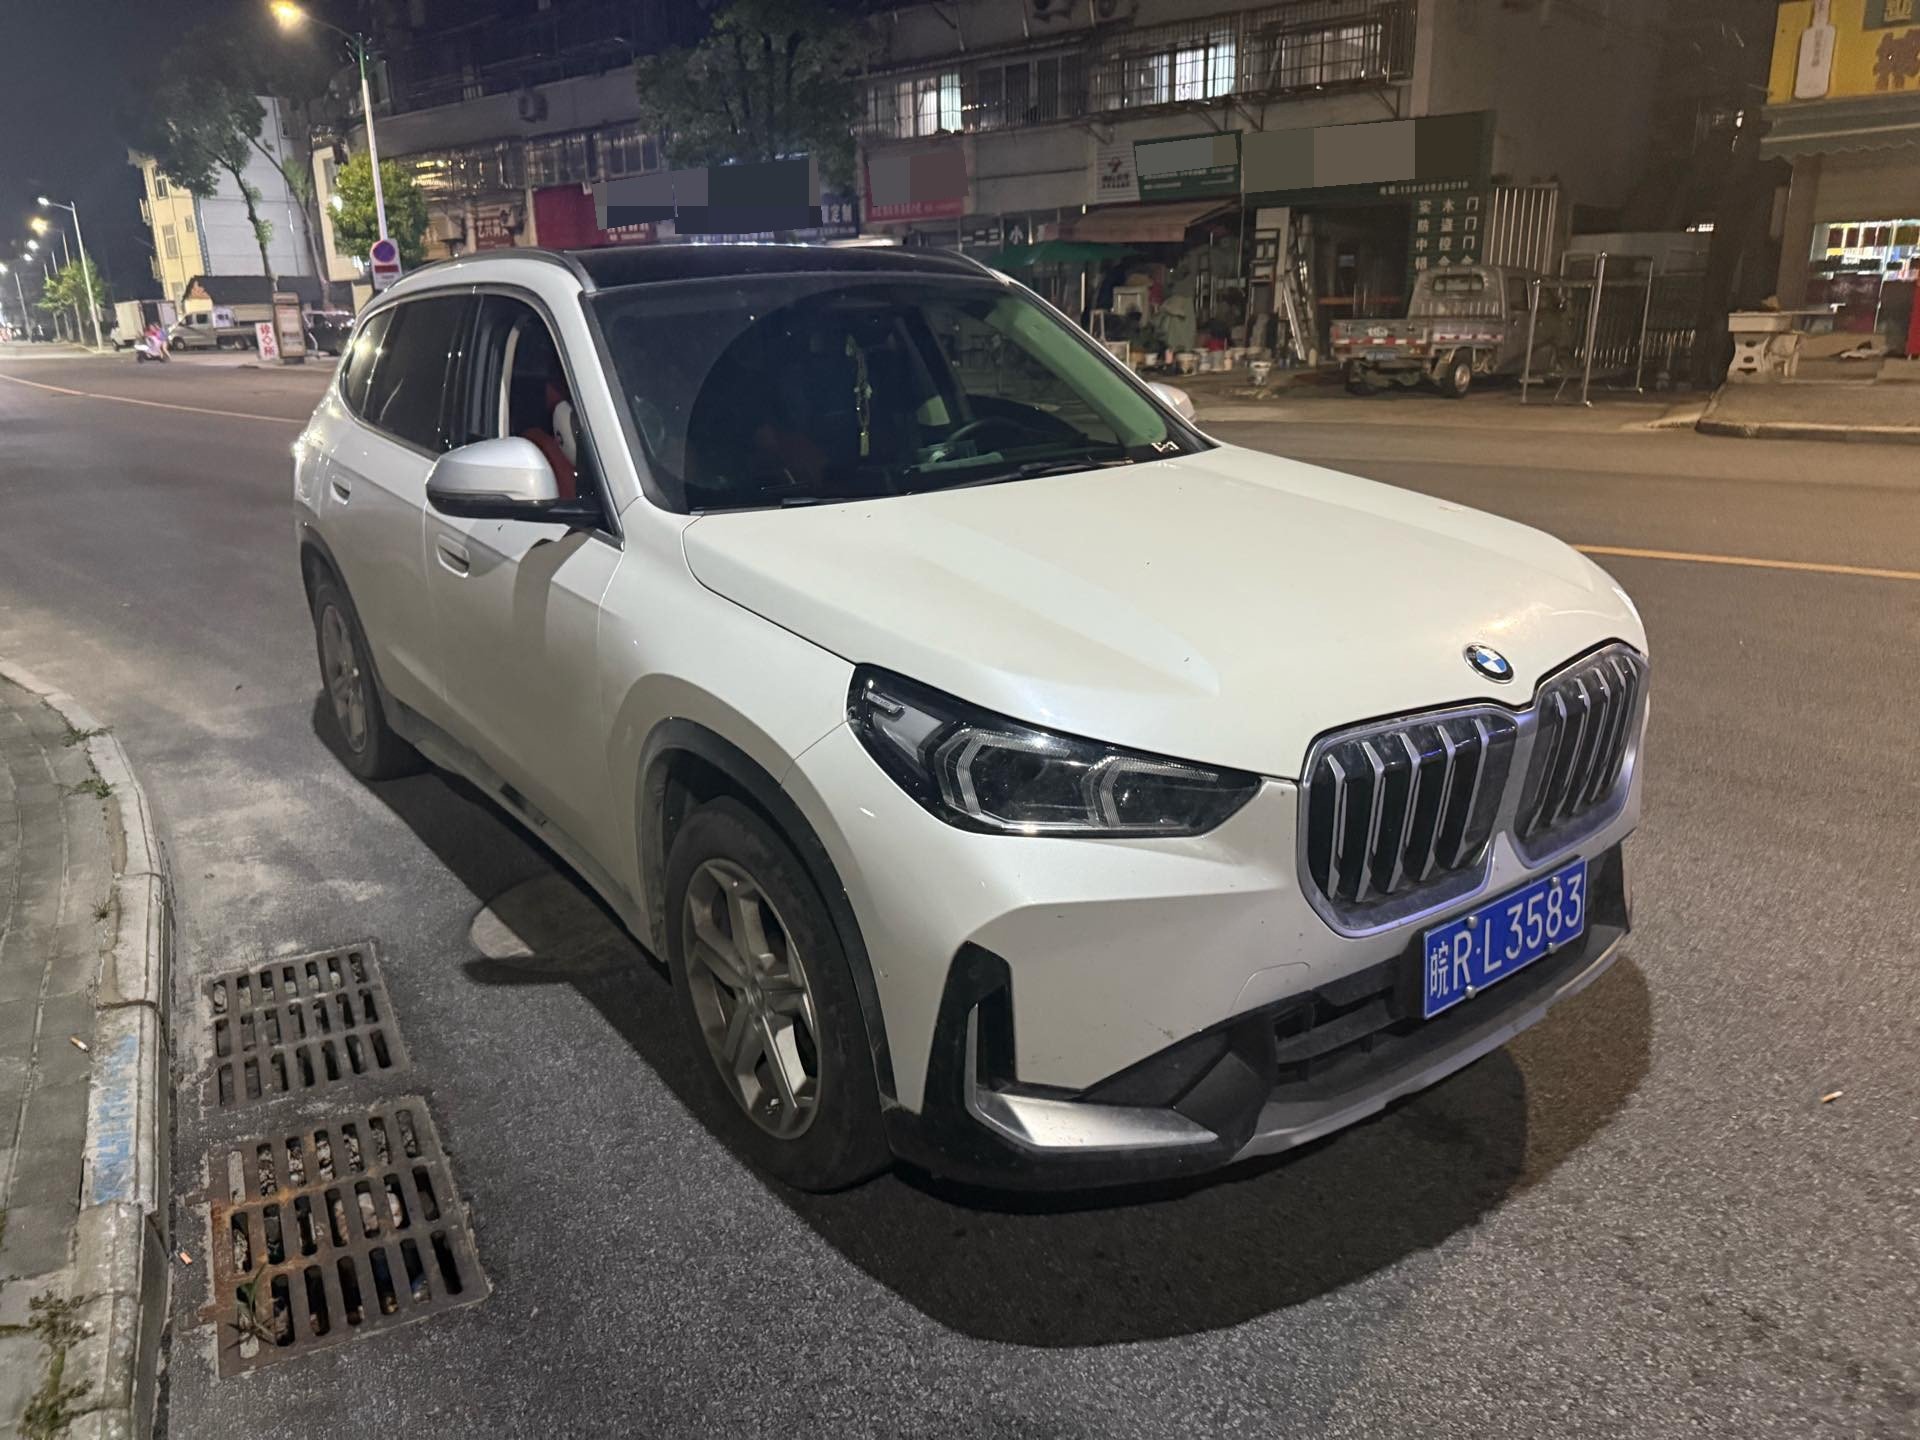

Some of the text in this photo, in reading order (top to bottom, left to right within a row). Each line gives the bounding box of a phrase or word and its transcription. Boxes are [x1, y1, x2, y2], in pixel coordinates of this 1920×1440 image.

[1419, 196, 1479, 214] 实木门
[1417, 216, 1477, 233] 防盗门
